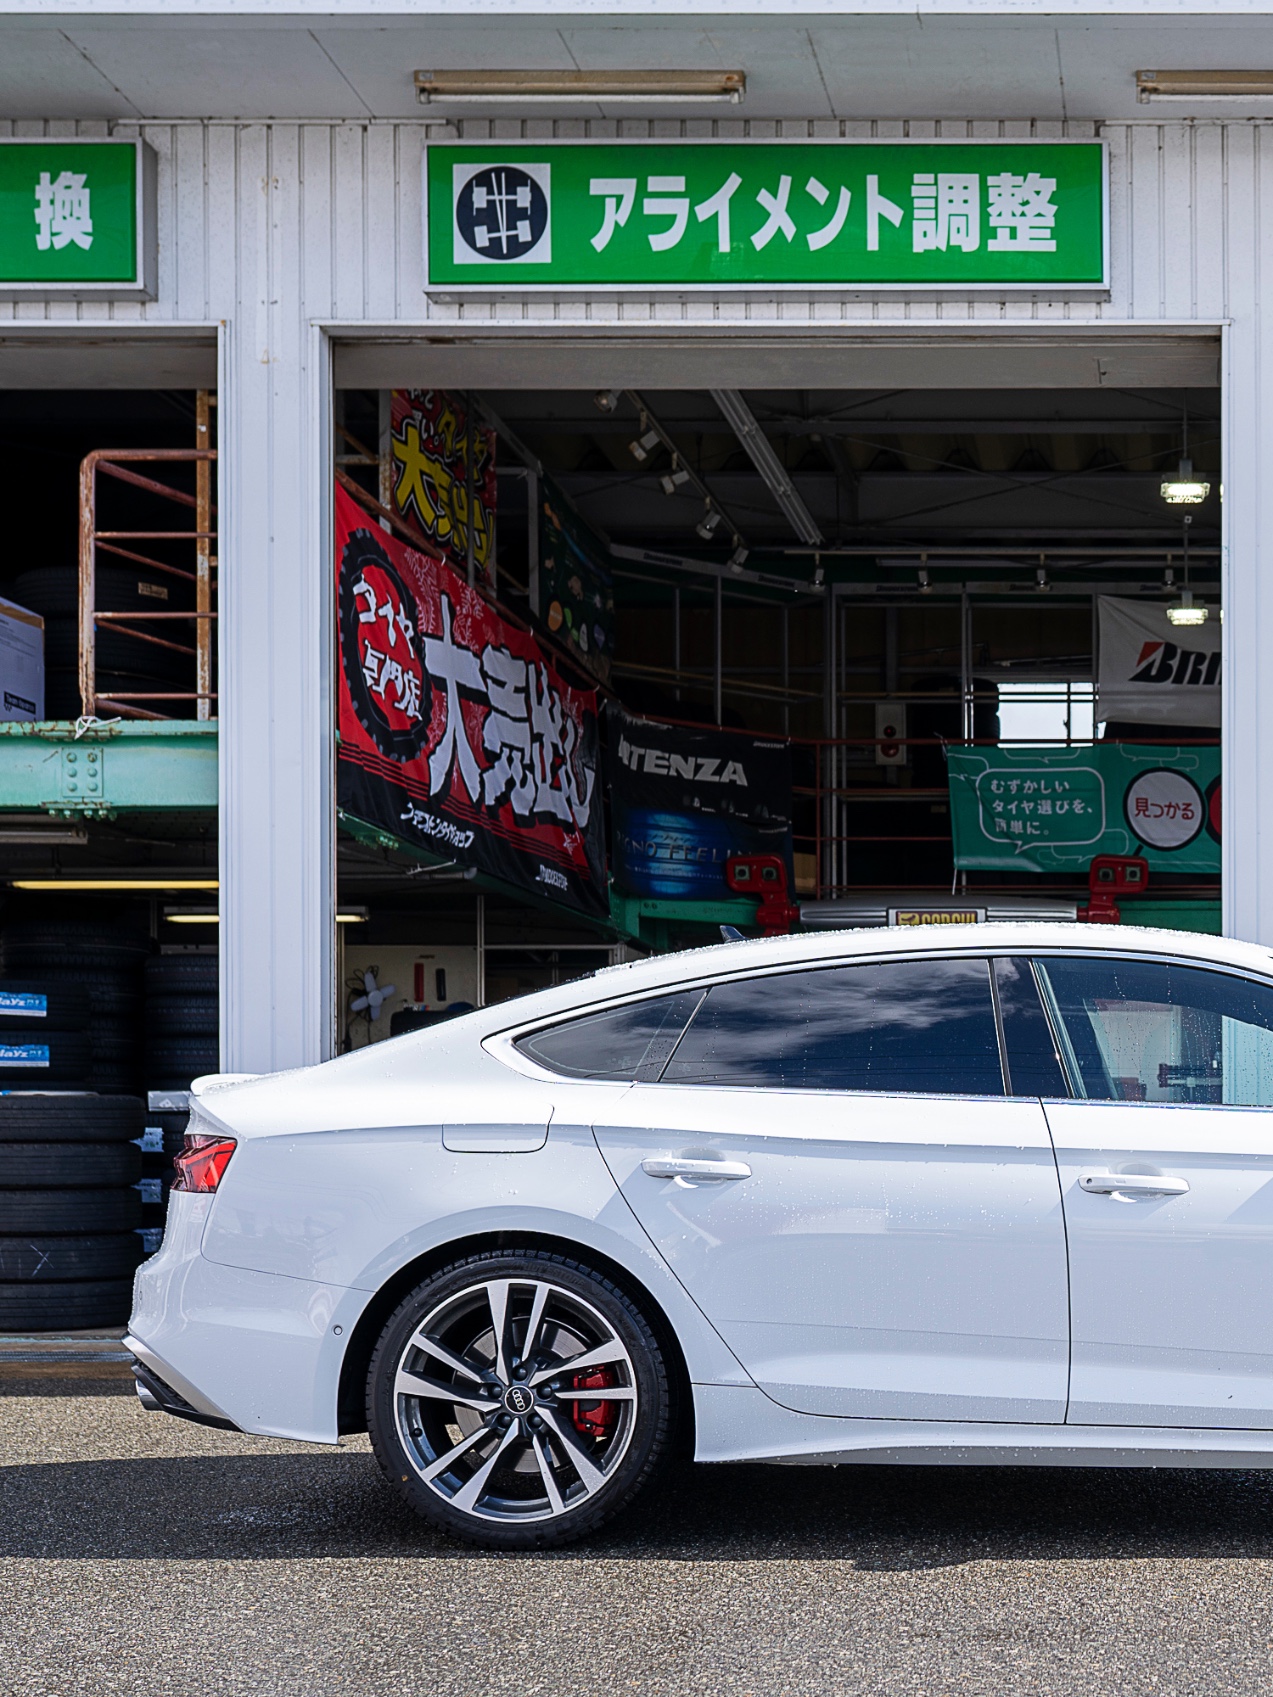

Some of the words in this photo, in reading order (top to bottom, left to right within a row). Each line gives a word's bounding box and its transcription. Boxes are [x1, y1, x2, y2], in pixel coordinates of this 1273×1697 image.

[35, 171, 94, 251] 換
[589, 171, 1059, 254] アライメント調整
[990, 778, 1070, 795] むずかしい
[1134, 797, 1195, 821] 見つかる
